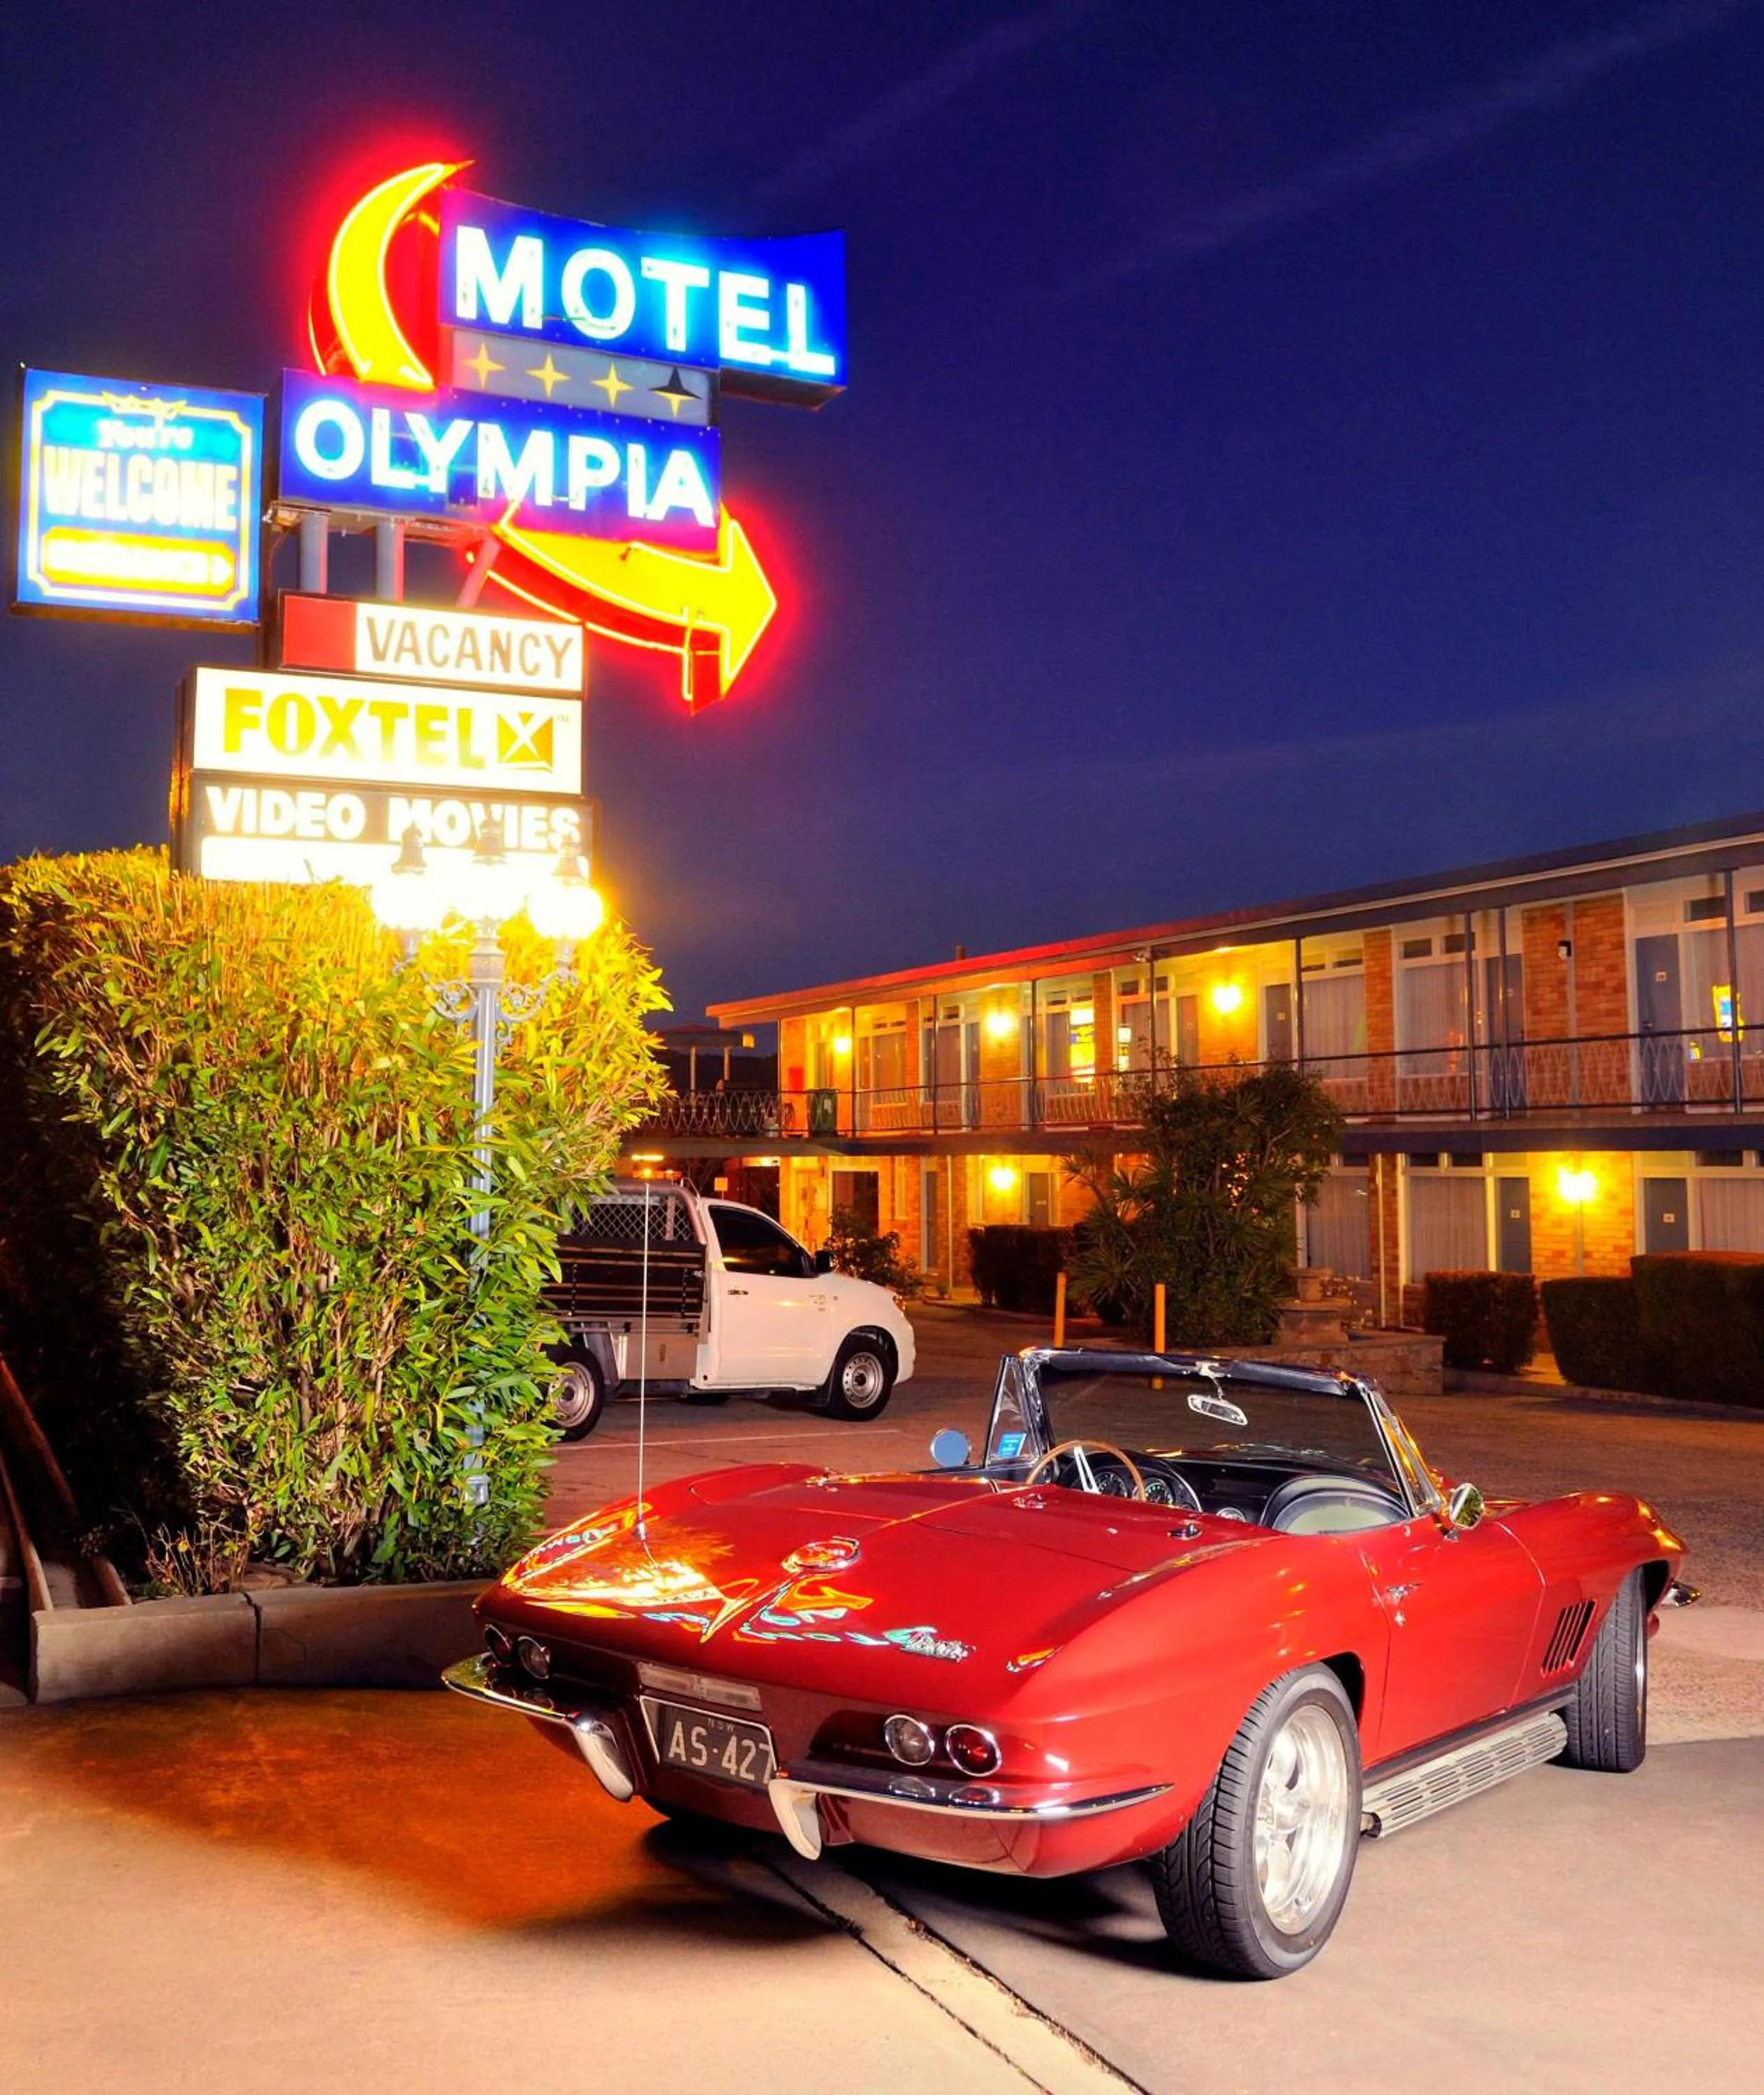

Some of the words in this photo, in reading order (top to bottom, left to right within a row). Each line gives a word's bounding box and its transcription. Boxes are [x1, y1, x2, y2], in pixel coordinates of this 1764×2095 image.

[455, 224, 835, 376] MOTEL
[42, 444, 238, 531] WELCOME
[295, 398, 716, 528] OLYMPIA
[365, 615, 573, 679] VACANCY
[223, 687, 486, 770] FOXTEL
[205, 785, 367, 841] VIDEO
[387, 796, 581, 851] MOVIES
